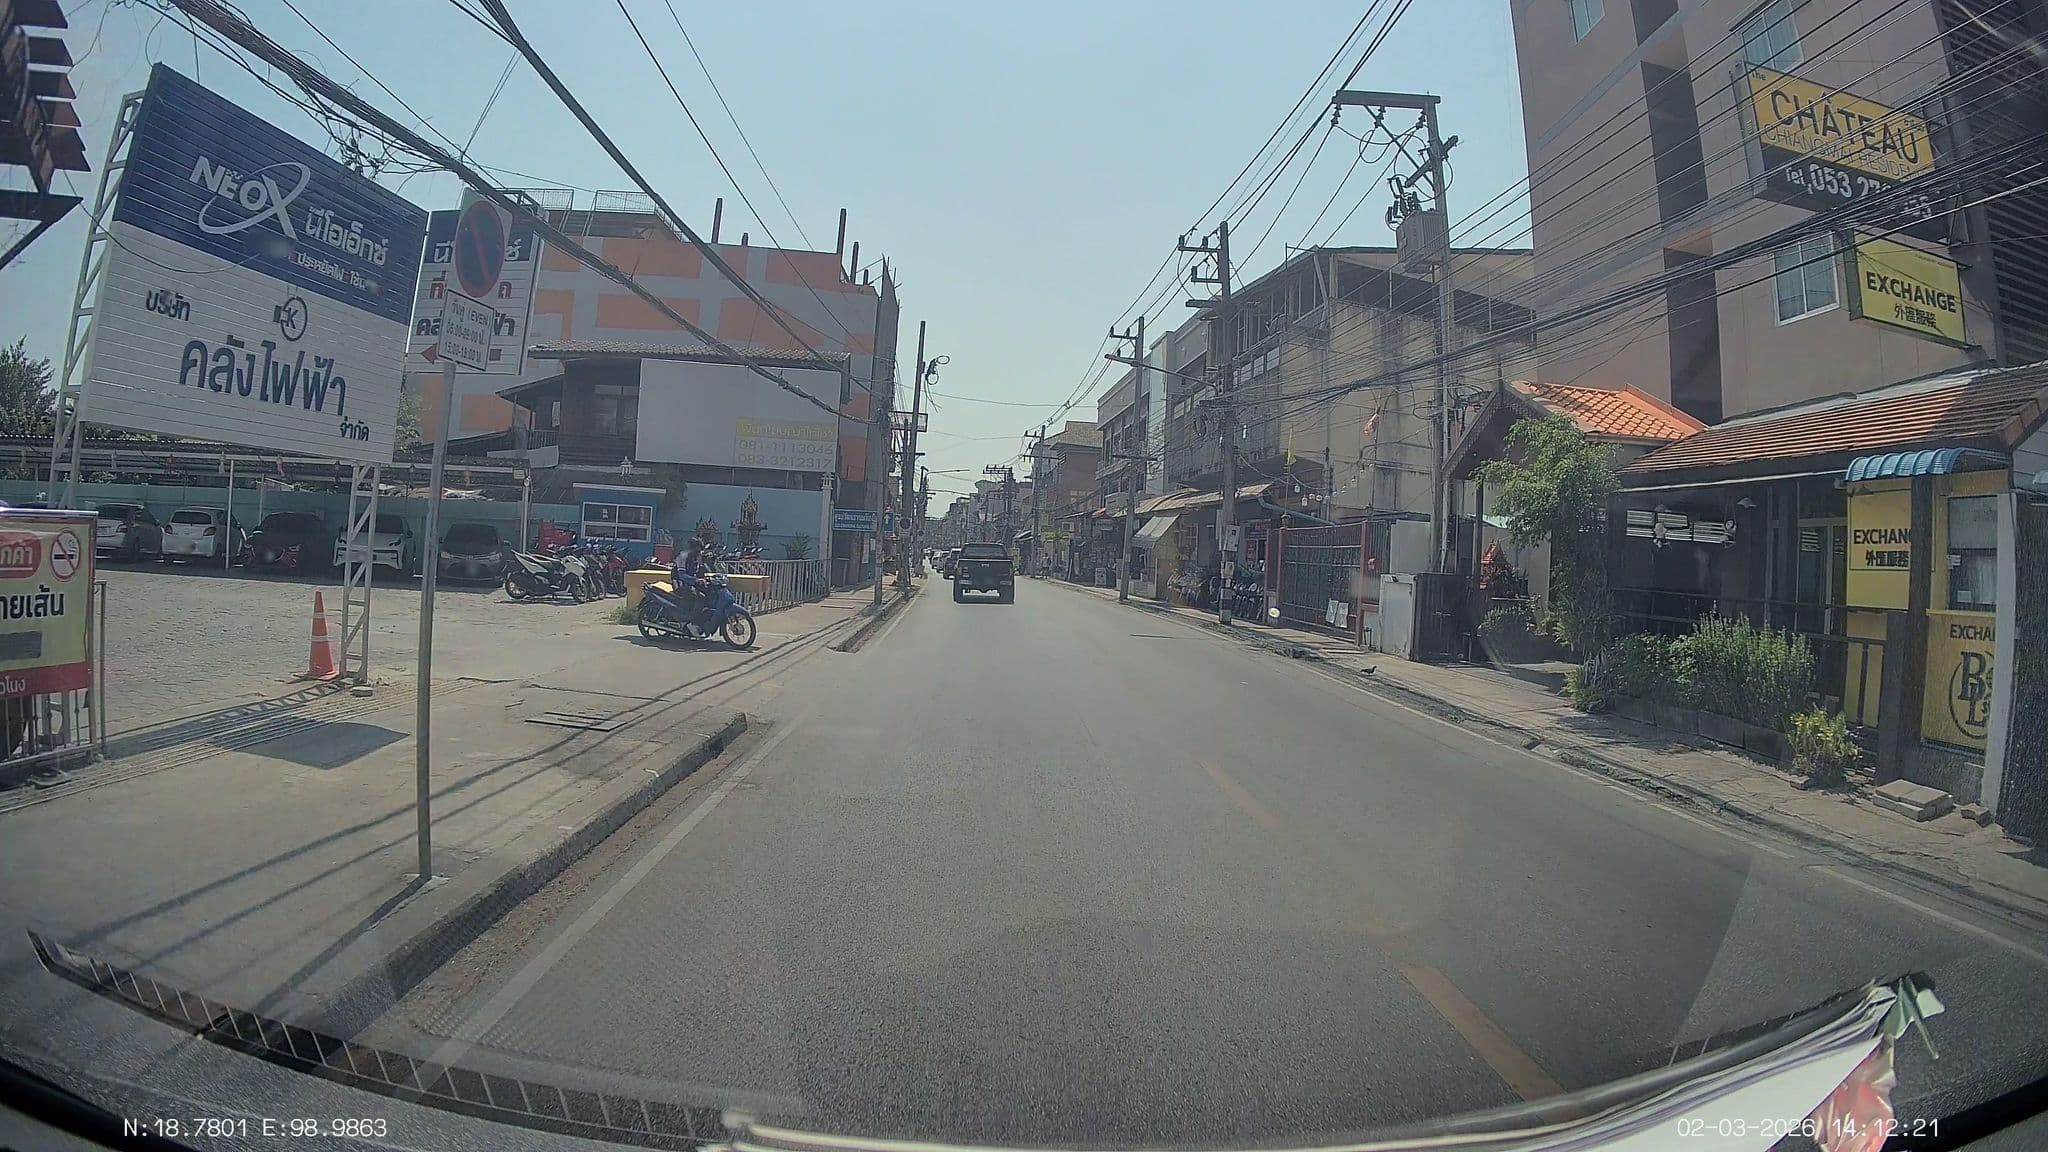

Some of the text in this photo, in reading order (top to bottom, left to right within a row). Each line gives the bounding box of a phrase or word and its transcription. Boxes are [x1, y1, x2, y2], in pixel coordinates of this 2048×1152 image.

[146, 289, 191, 322] บริษัท
[1866, 270, 1957, 314] EXCHANGE
[179, 334, 347, 417] คลังไฟฟ้า
[340, 416, 370, 442] จำกัด
[1853, 528, 1911, 545] EXCHAN
